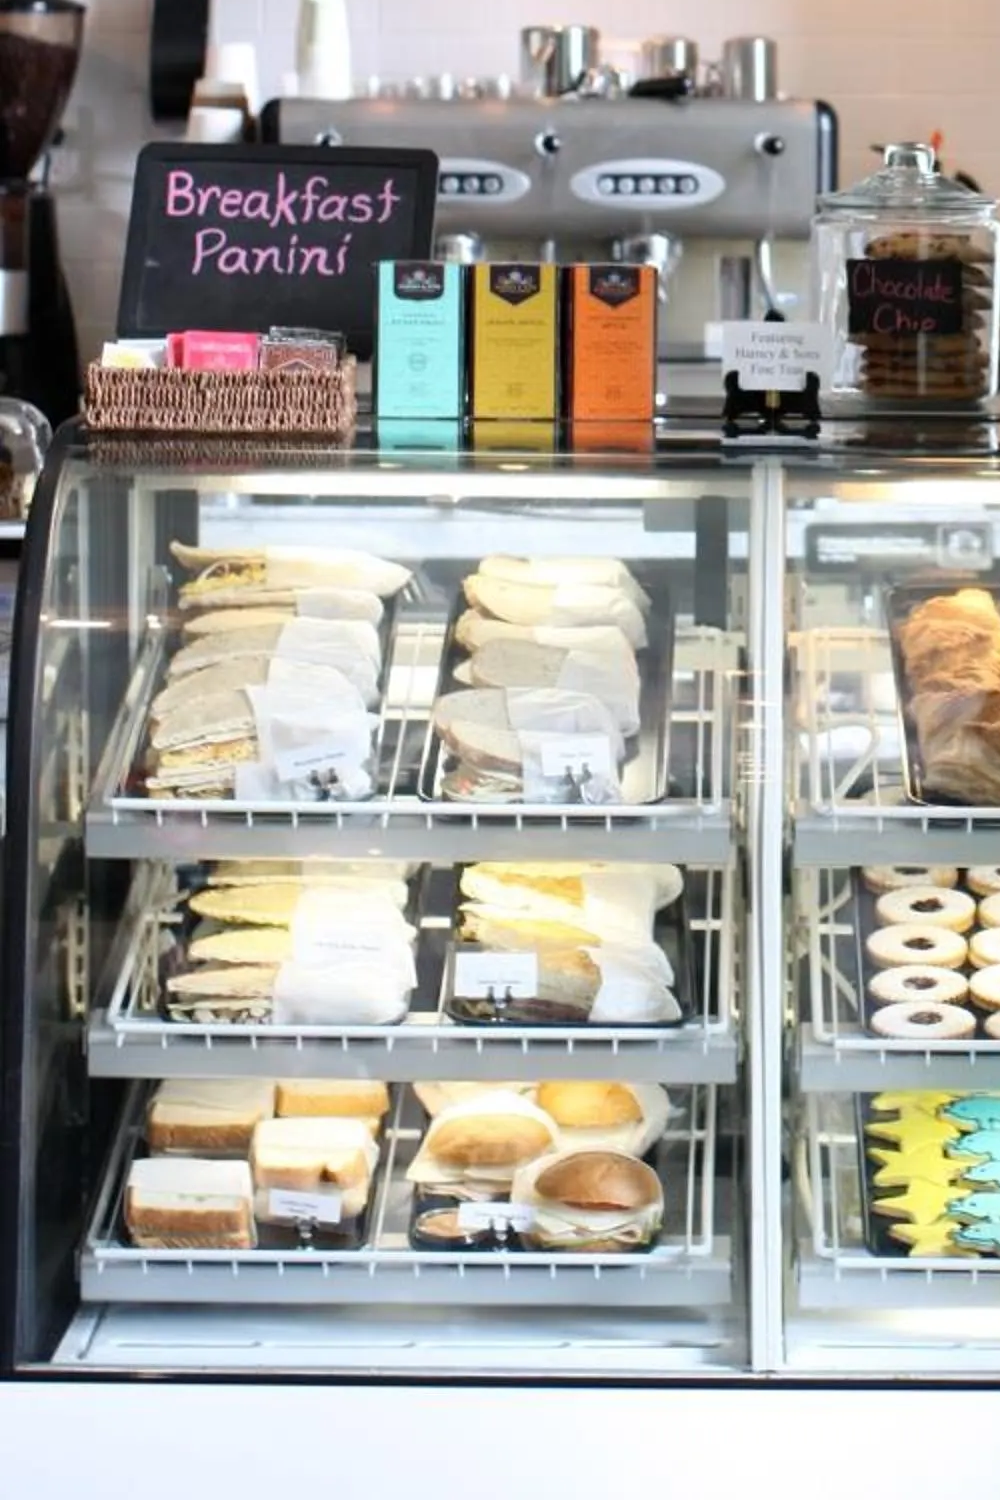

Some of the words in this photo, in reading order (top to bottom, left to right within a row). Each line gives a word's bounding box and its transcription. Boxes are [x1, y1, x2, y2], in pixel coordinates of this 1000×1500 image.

[166, 170, 400, 228] Breakfast
[191, 228, 352, 275] Panini
[852, 262, 955, 304] Chocolate
[751, 331, 804, 344] Featuring
[735, 348, 776, 360] Harney
[778, 348, 790, 359] &
[751, 363, 775, 375] Fine
